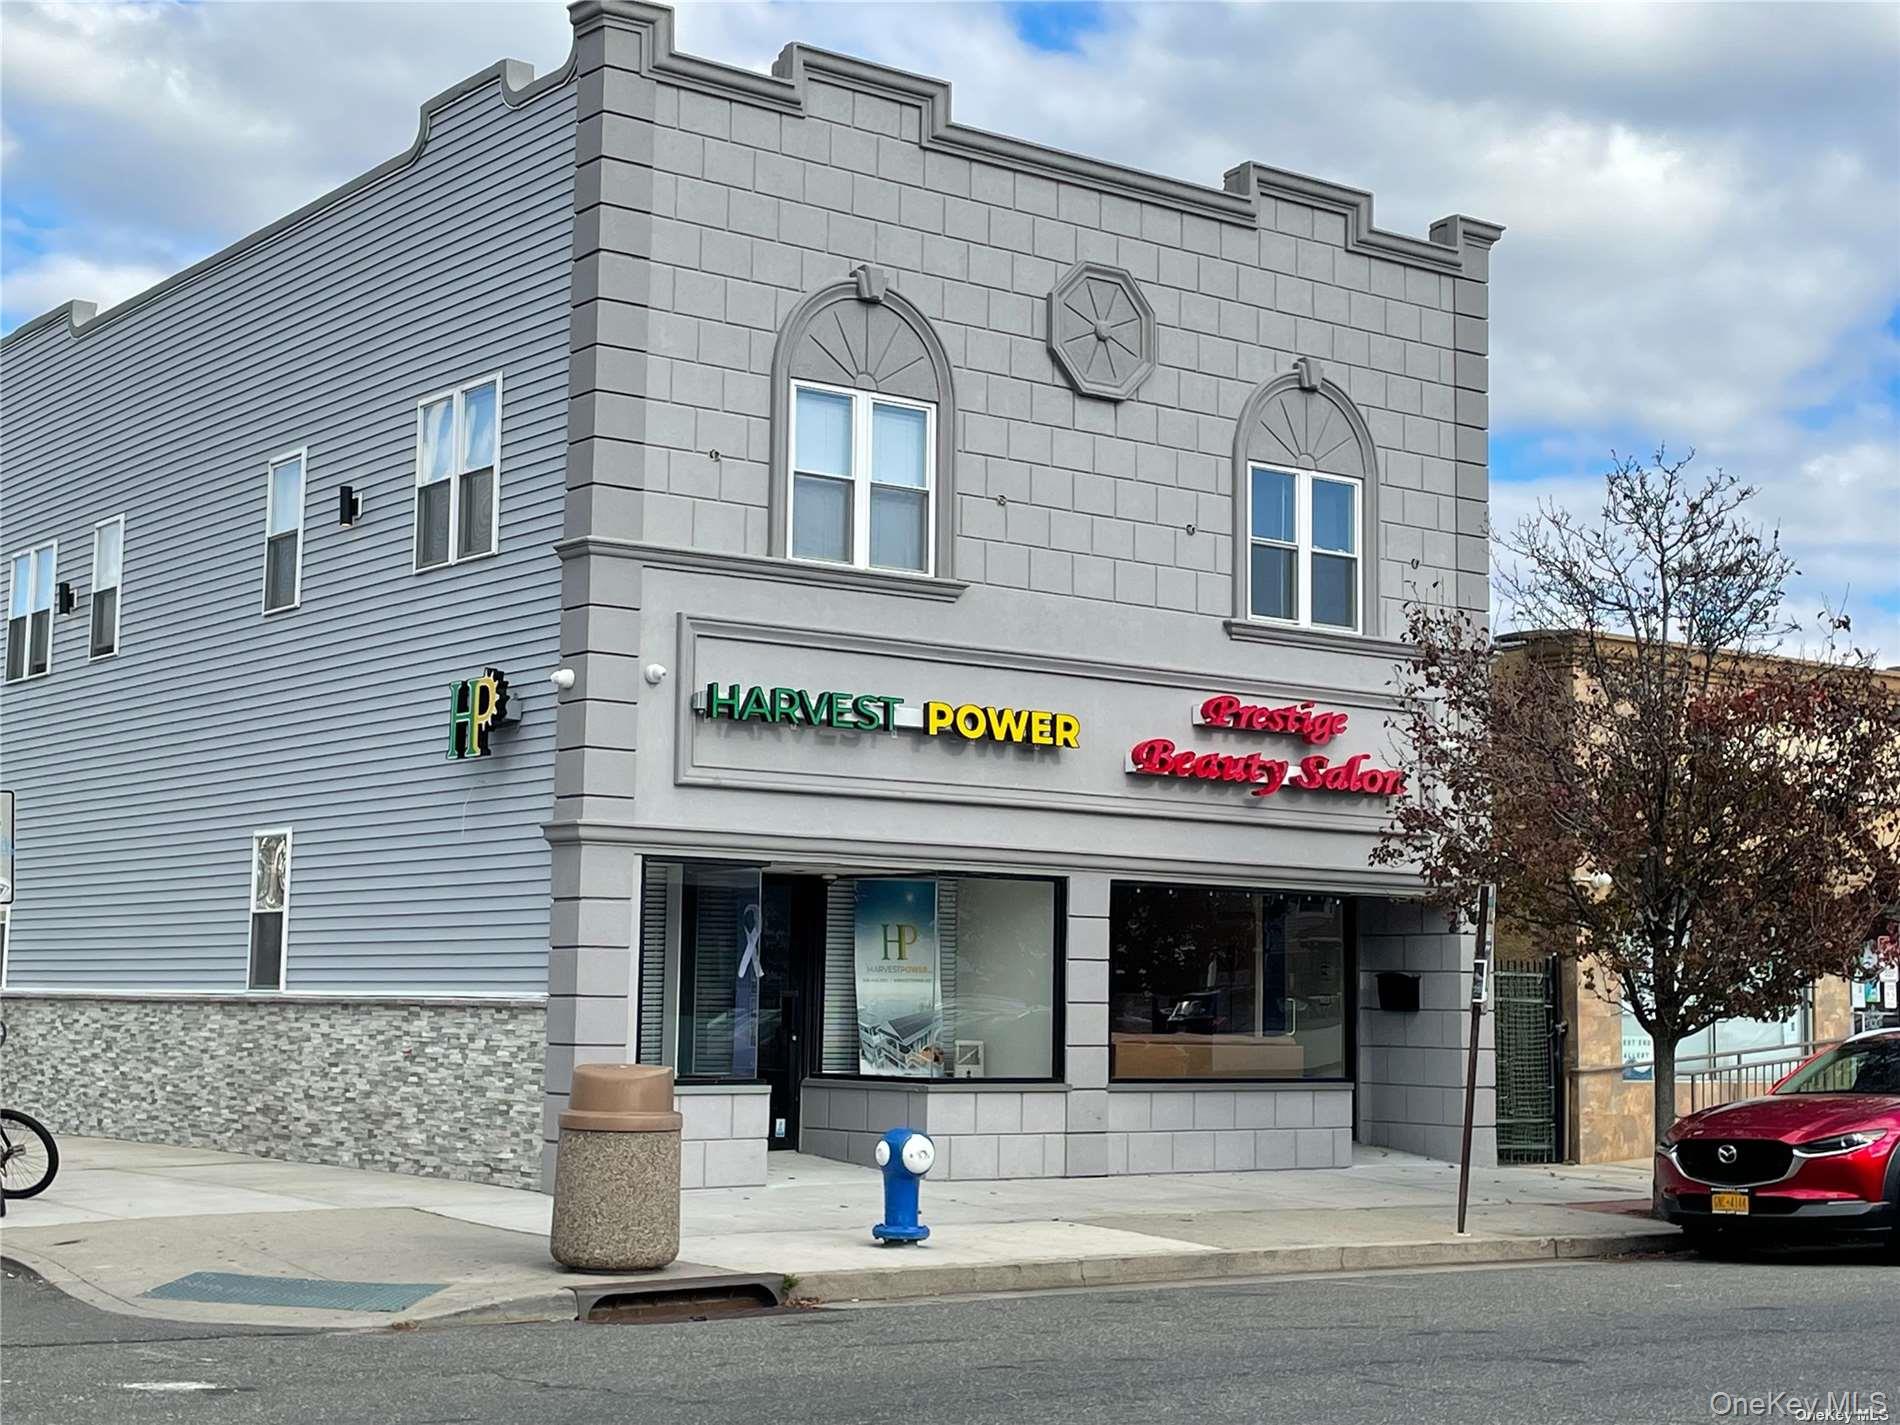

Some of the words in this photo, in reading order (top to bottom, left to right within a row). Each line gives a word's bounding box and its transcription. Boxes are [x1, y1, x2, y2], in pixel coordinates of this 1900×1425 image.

[706, 681, 904, 731] HARVEST
[923, 700, 1081, 748] POWER
[1200, 695, 1349, 745] Prestige
[1131, 738, 1288, 797] Beauty
[1290, 753, 1408, 794] Salon
[881, 924, 917, 960] HP
